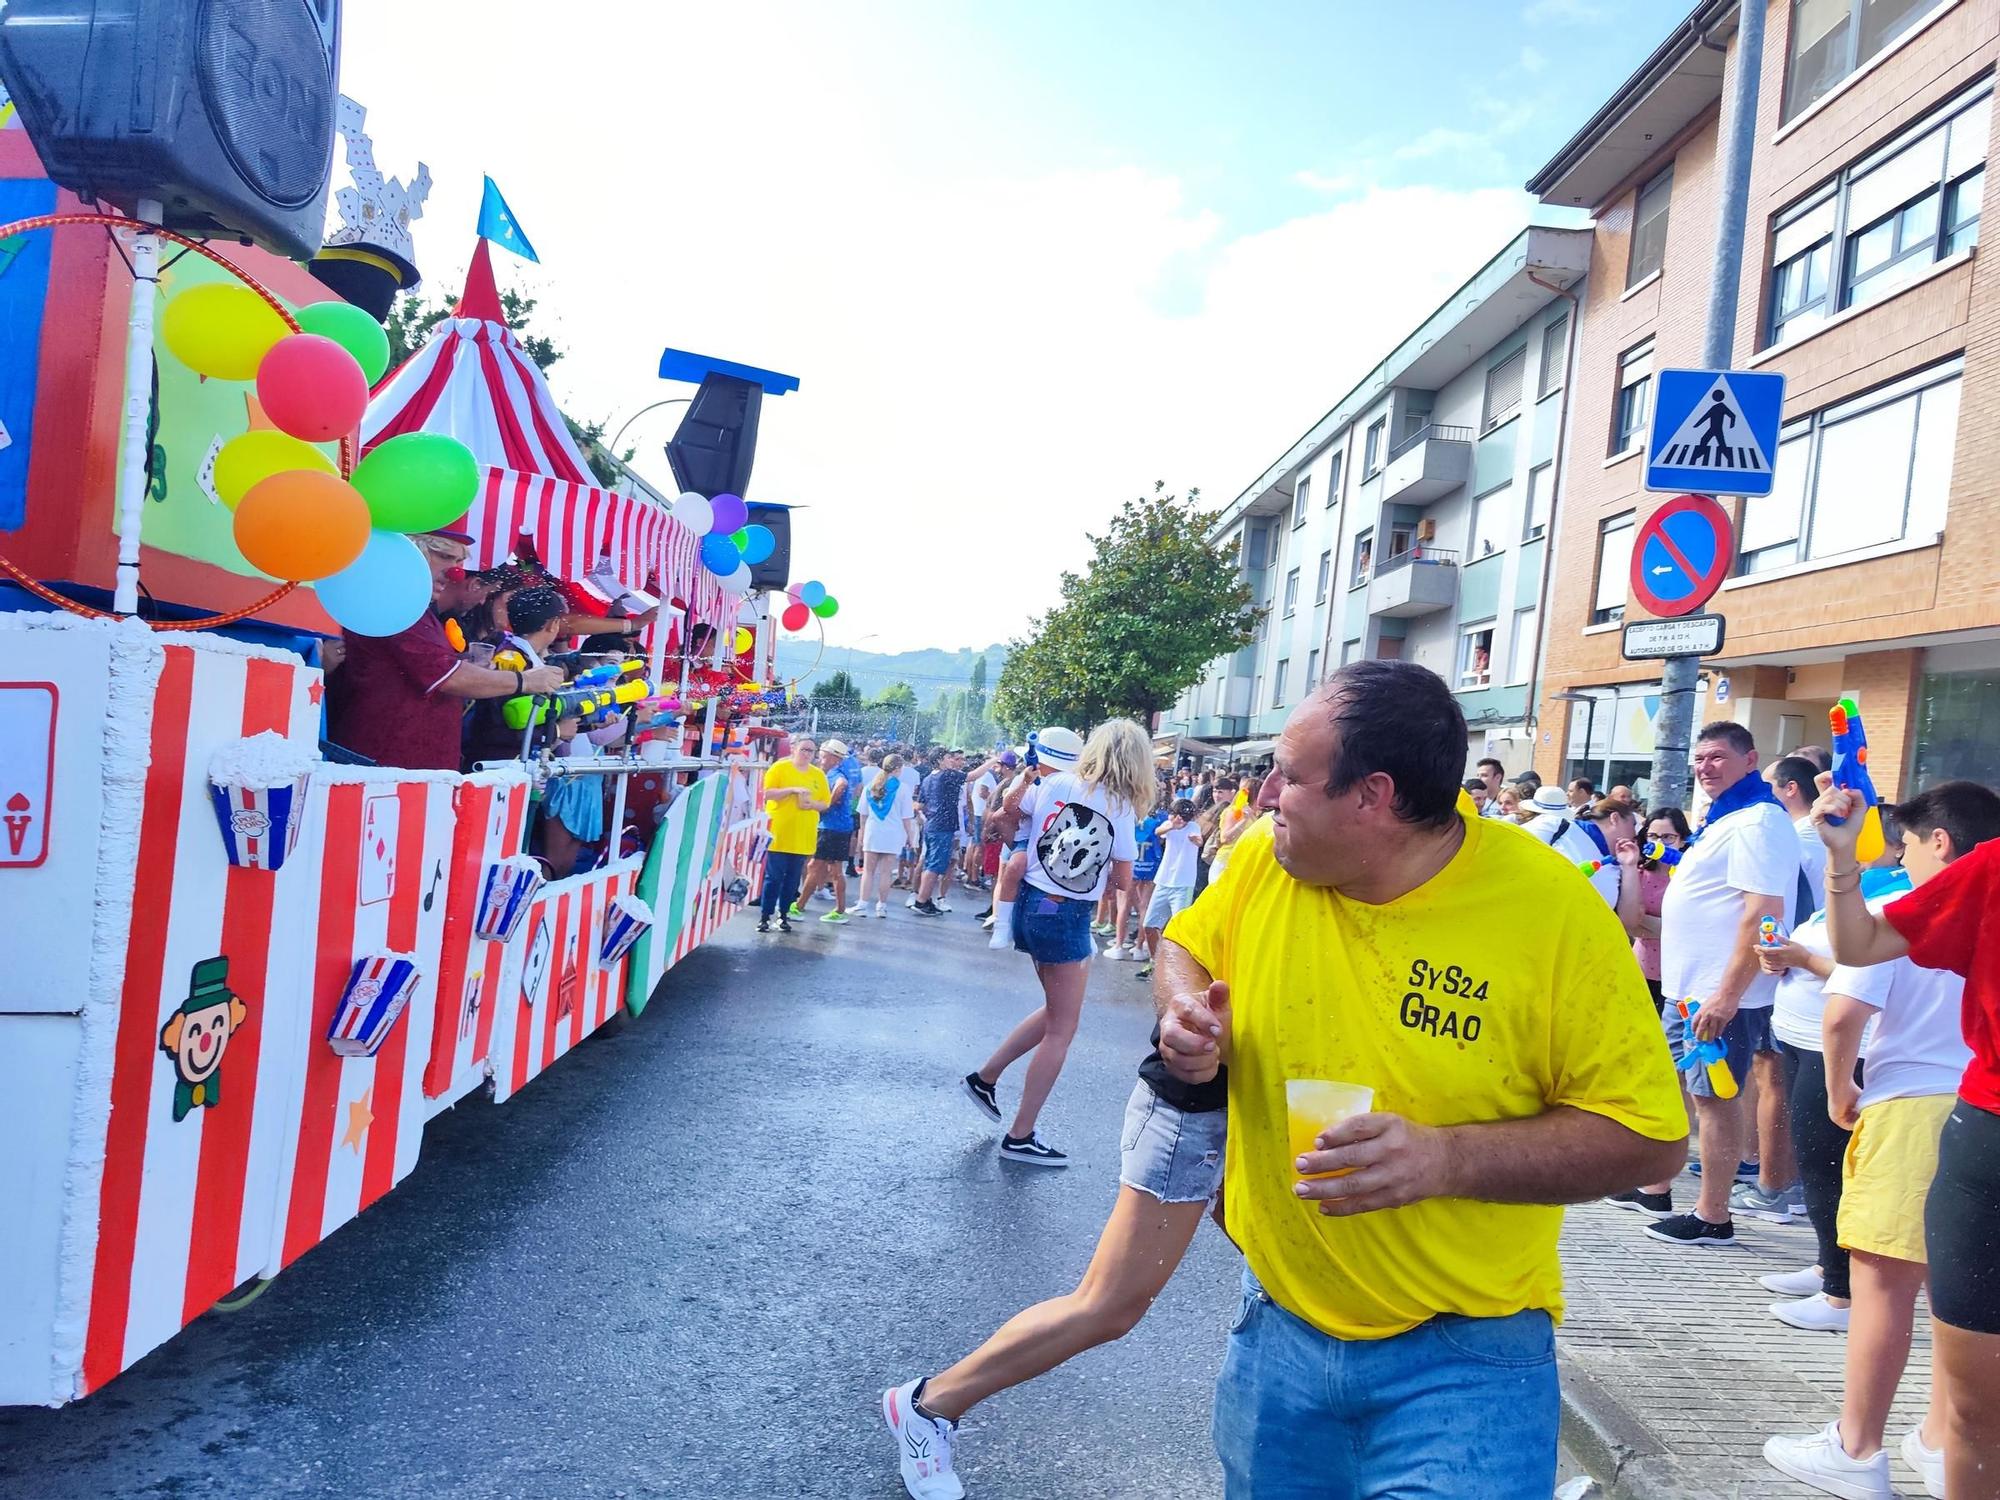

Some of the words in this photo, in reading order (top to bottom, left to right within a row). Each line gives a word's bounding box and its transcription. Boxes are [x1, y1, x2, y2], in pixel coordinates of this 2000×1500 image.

[1682, 620, 1716, 628] DESCARGA
[1630, 646, 1665, 654] AUTORIZADO
[3, 815, 32, 855] A
